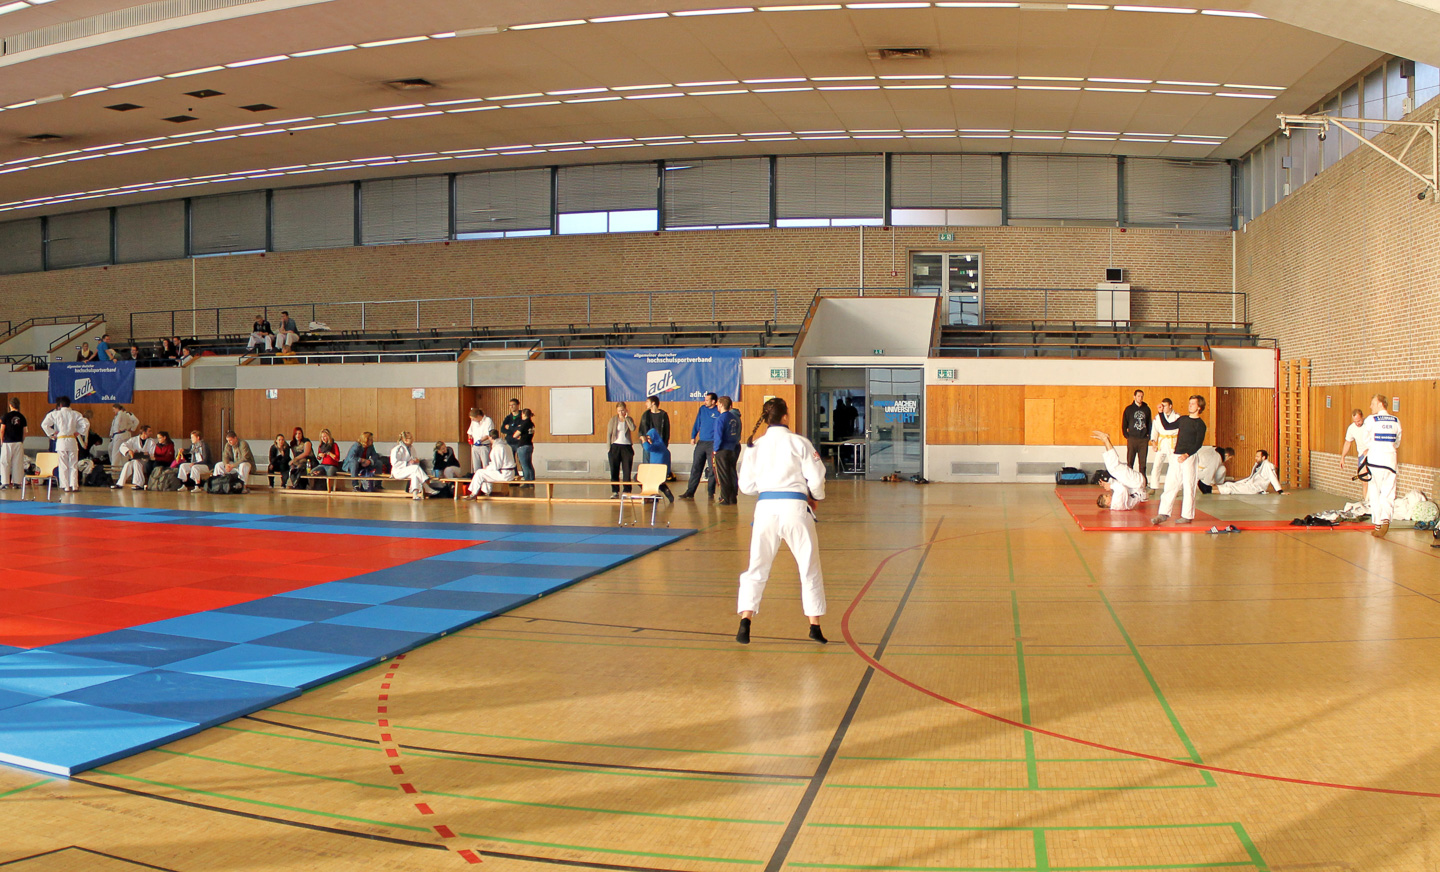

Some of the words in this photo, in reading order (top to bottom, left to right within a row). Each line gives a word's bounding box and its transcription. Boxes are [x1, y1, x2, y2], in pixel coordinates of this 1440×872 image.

[646, 356, 713, 364] hochschulsportverband
[75, 379, 93, 398] adh
[648, 371, 675, 395] adh
[689, 390, 707, 398] adh.d
[885, 412, 916, 423] SPORT
